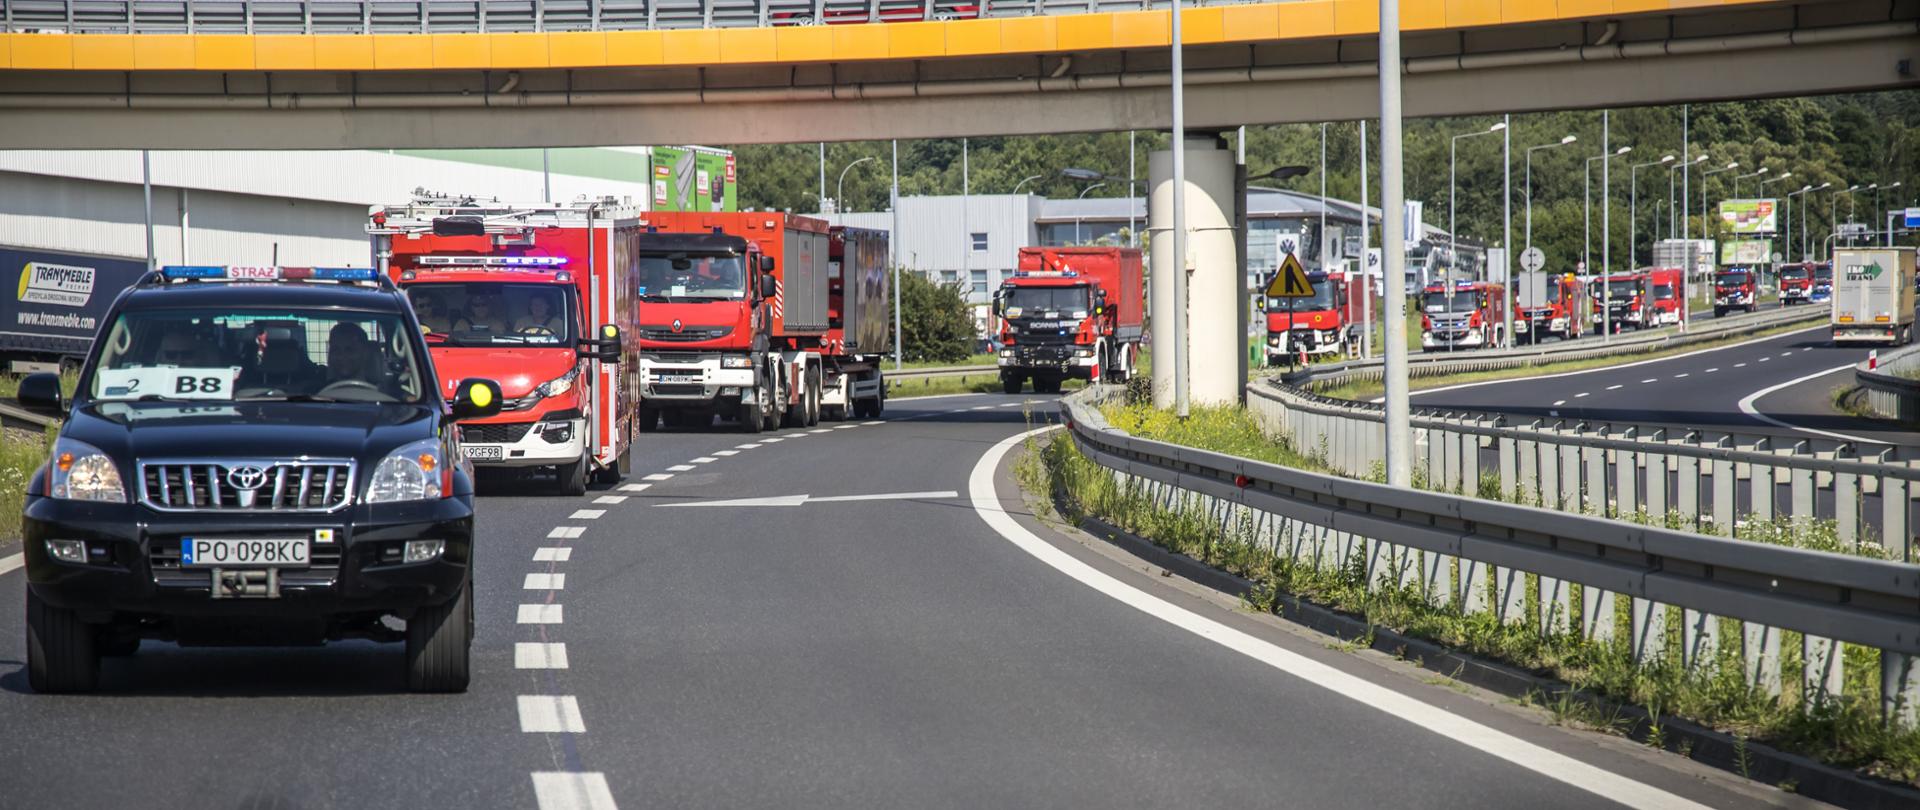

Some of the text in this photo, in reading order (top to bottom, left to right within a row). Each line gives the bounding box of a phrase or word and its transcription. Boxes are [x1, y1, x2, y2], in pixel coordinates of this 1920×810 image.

[34, 266, 92, 286] TRANSMEBLE
[17, 311, 96, 329] www.transmeble.com
[127, 375, 222, 394] 2 B8
[1415, 428, 1428, 445] 2
[469, 447, 500, 457] 9GF98
[196, 541, 305, 562] PO 098KC
